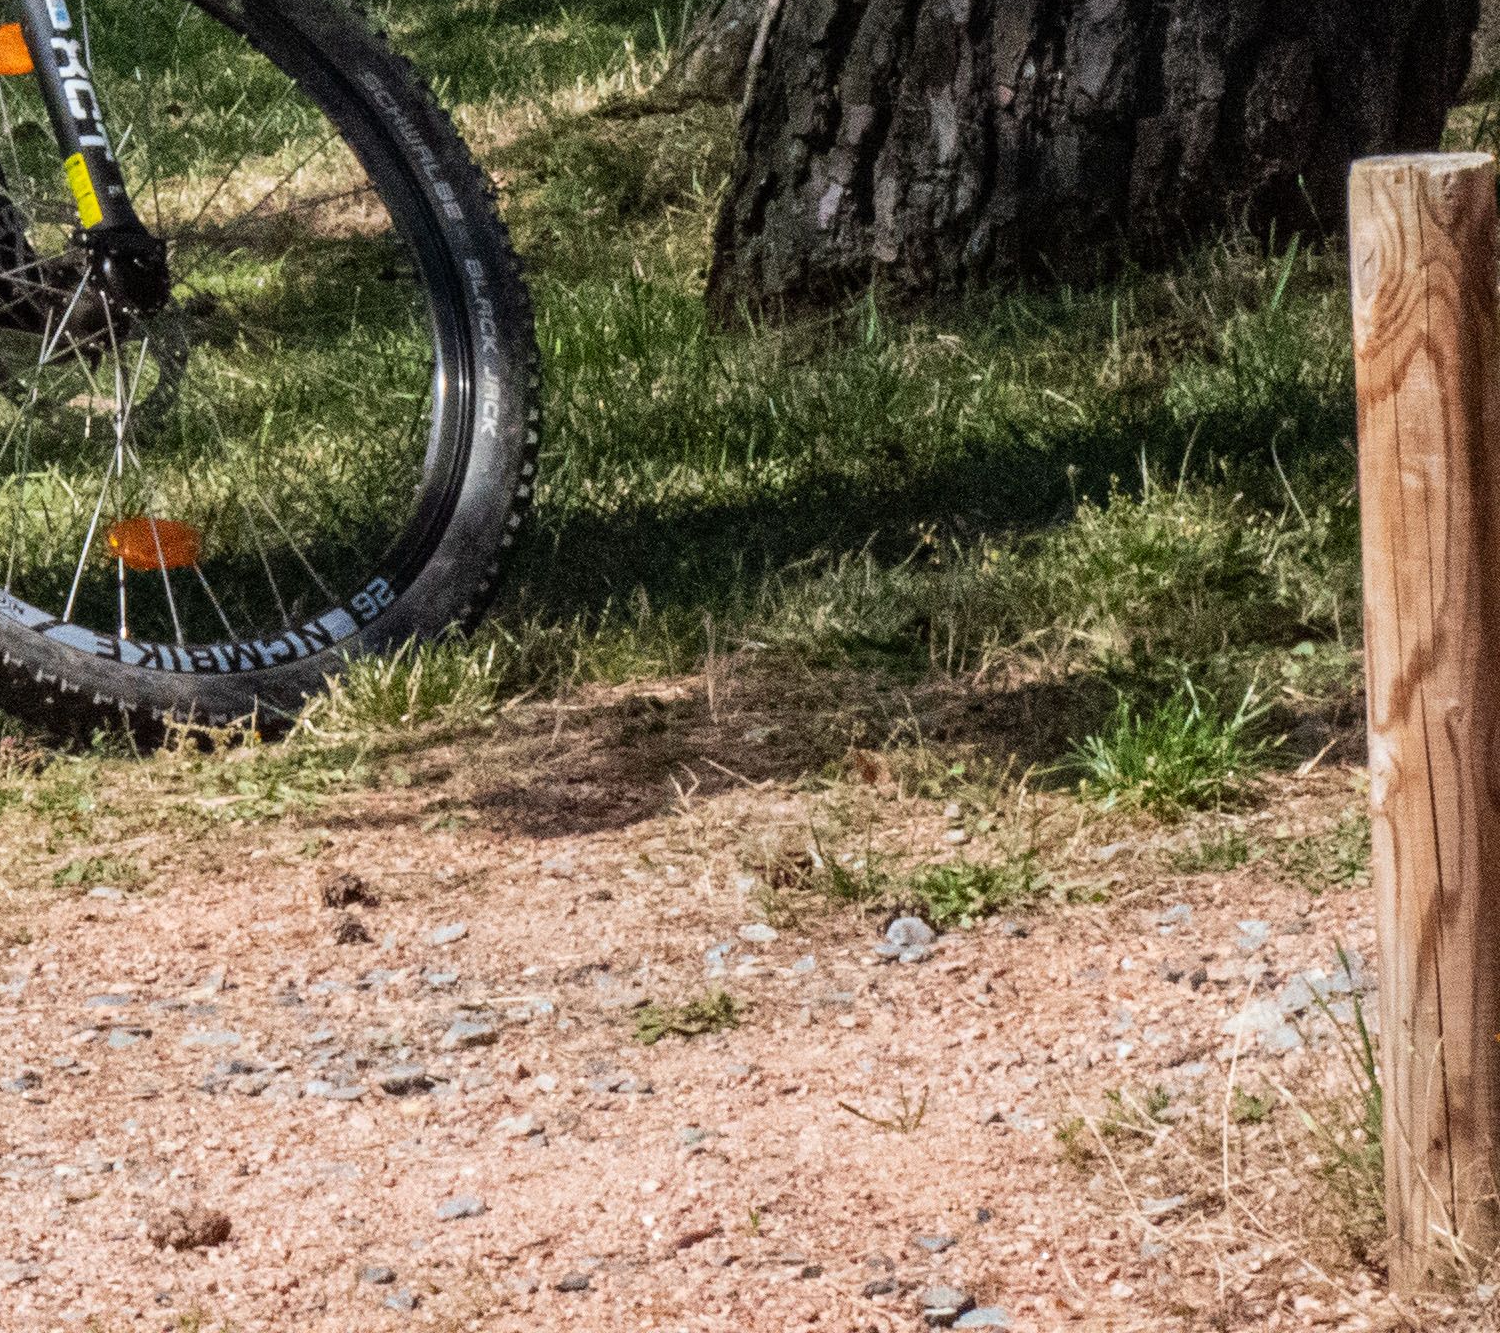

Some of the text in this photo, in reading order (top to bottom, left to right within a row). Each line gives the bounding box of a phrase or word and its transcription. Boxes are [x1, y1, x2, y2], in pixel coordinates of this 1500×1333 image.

[50, 36, 115, 163] XCT
[359, 71, 502, 438] SCHWALBE BLACK JACK
[96, 574, 397, 673] 26 NCMBIKE
